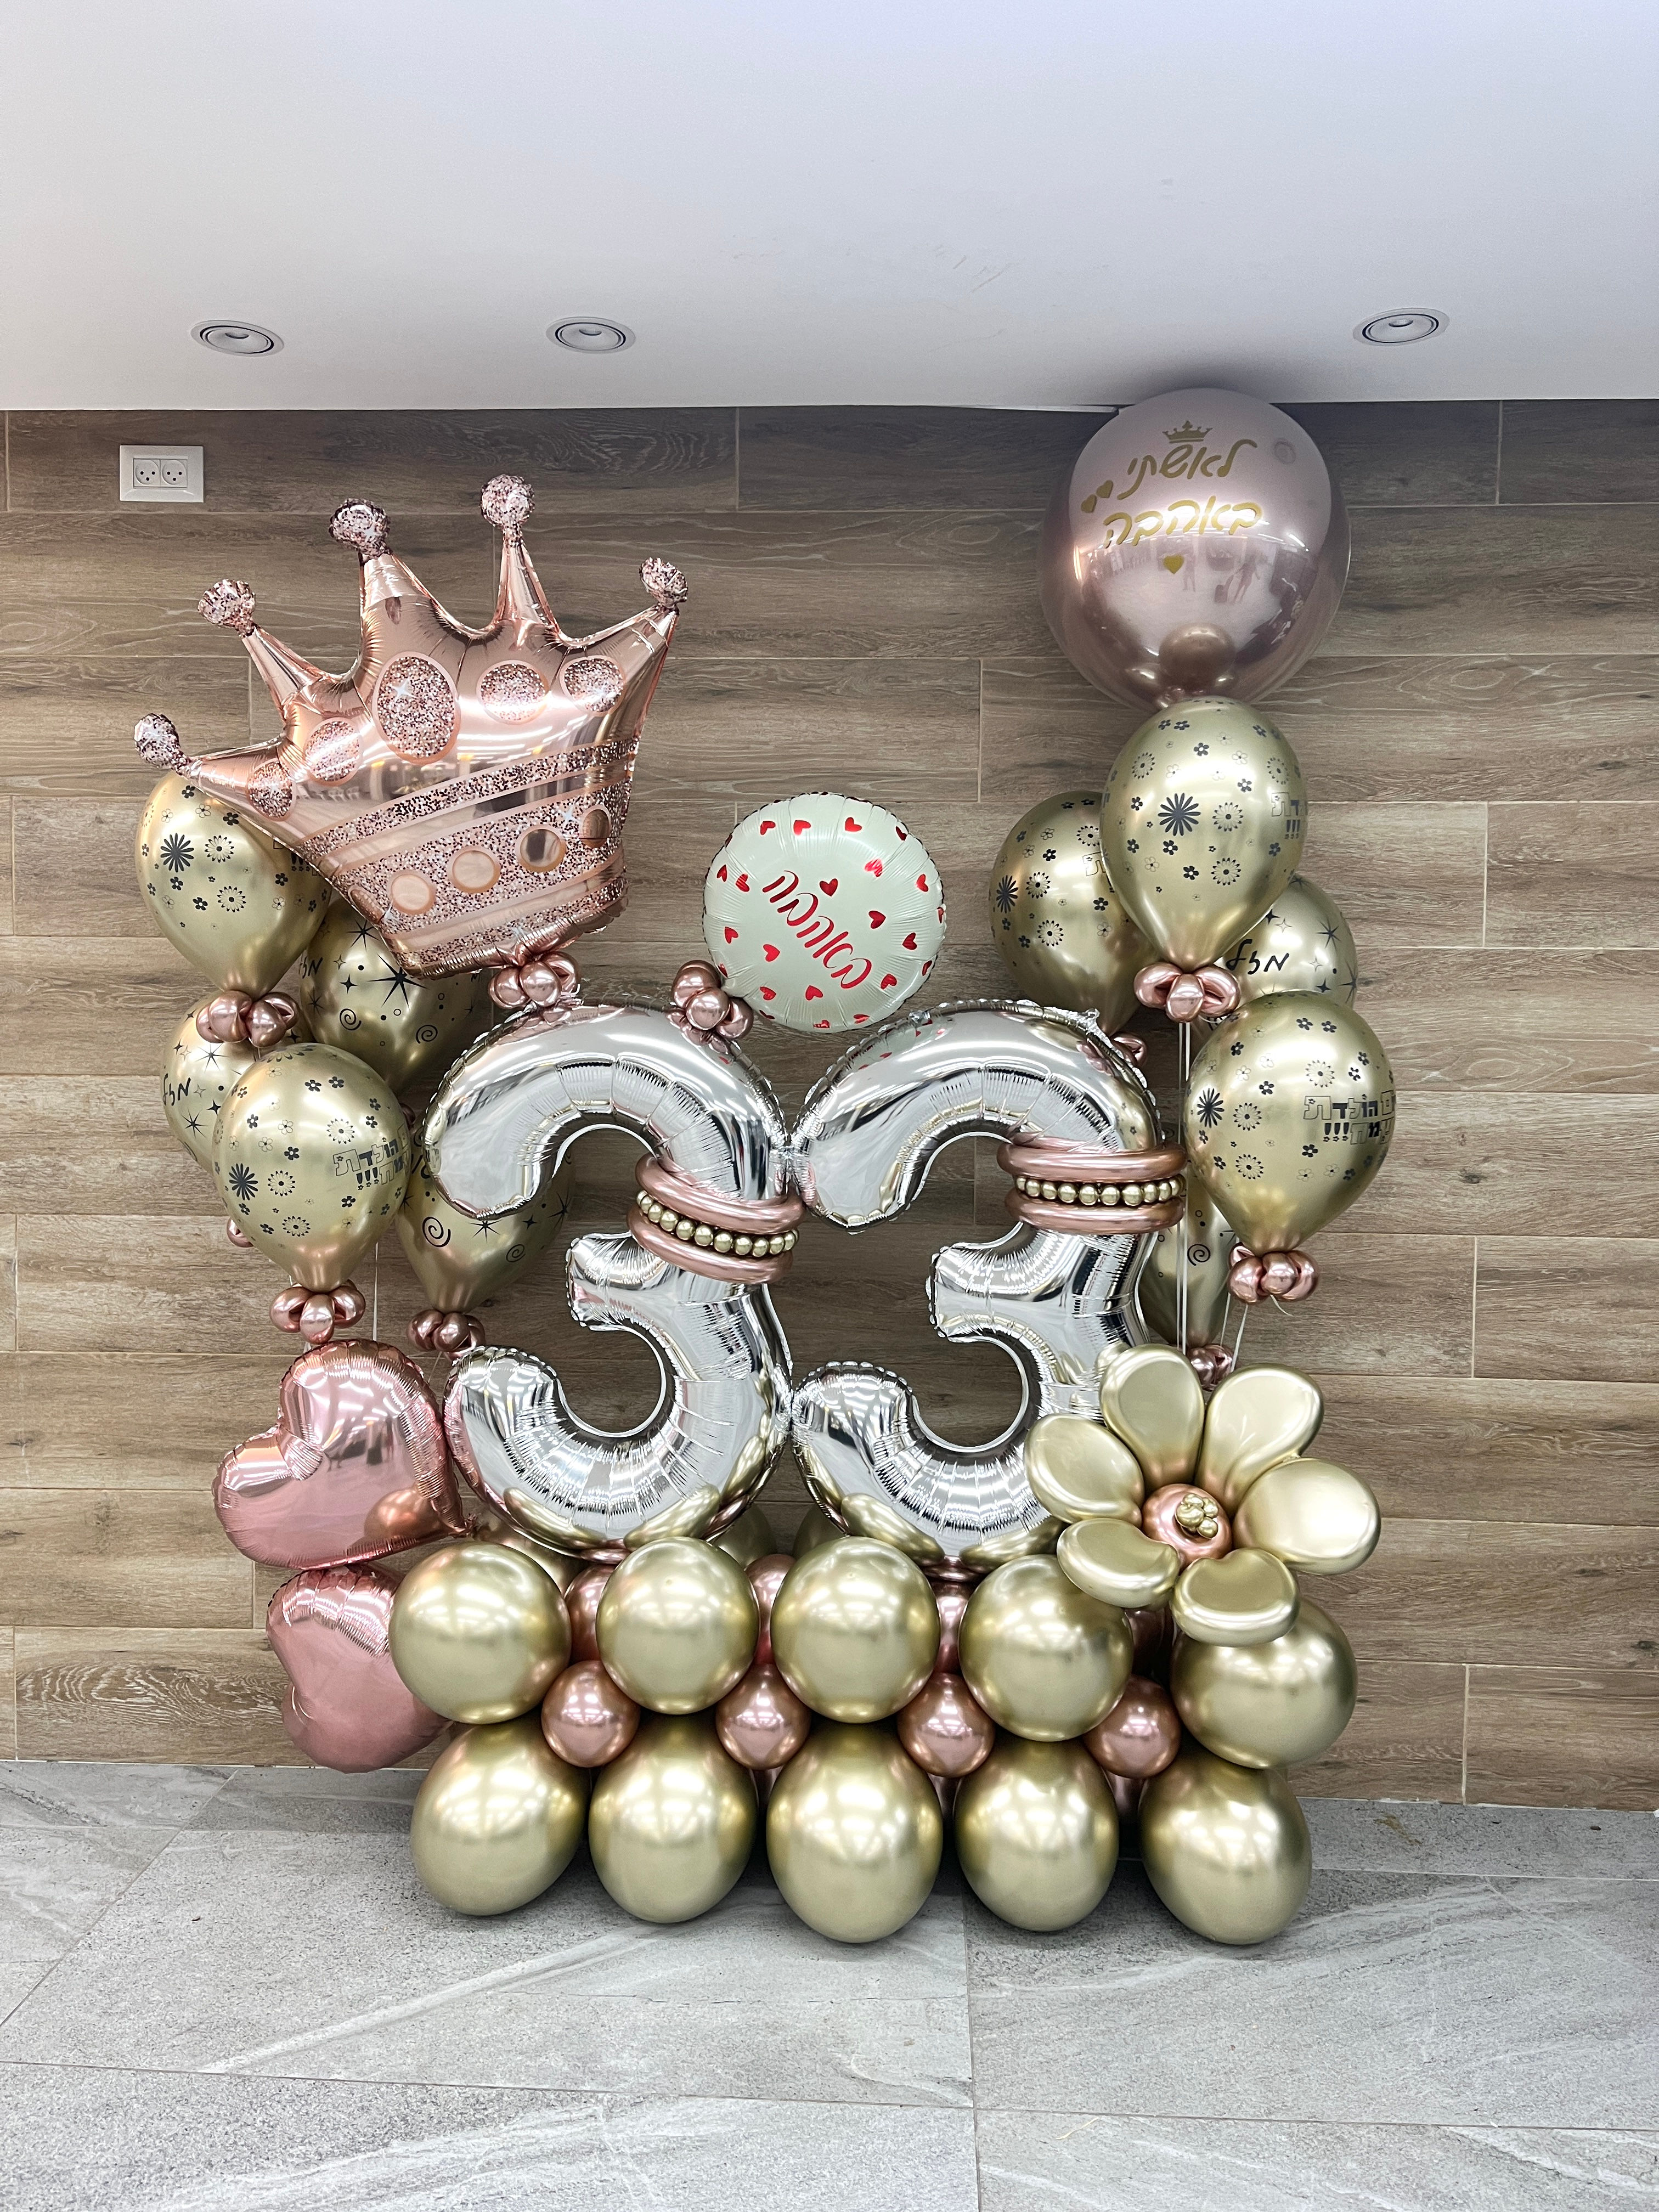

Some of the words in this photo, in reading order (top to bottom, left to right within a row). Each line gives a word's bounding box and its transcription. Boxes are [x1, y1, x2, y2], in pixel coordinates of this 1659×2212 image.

[1117, 439, 1257, 500] לאשתי
[1103, 495, 1262, 549] באהבה
[762, 870, 872, 989] באהבה
[1226, 939, 1290, 975] מזל
[1303, 1094, 1378, 1120] הולדת
